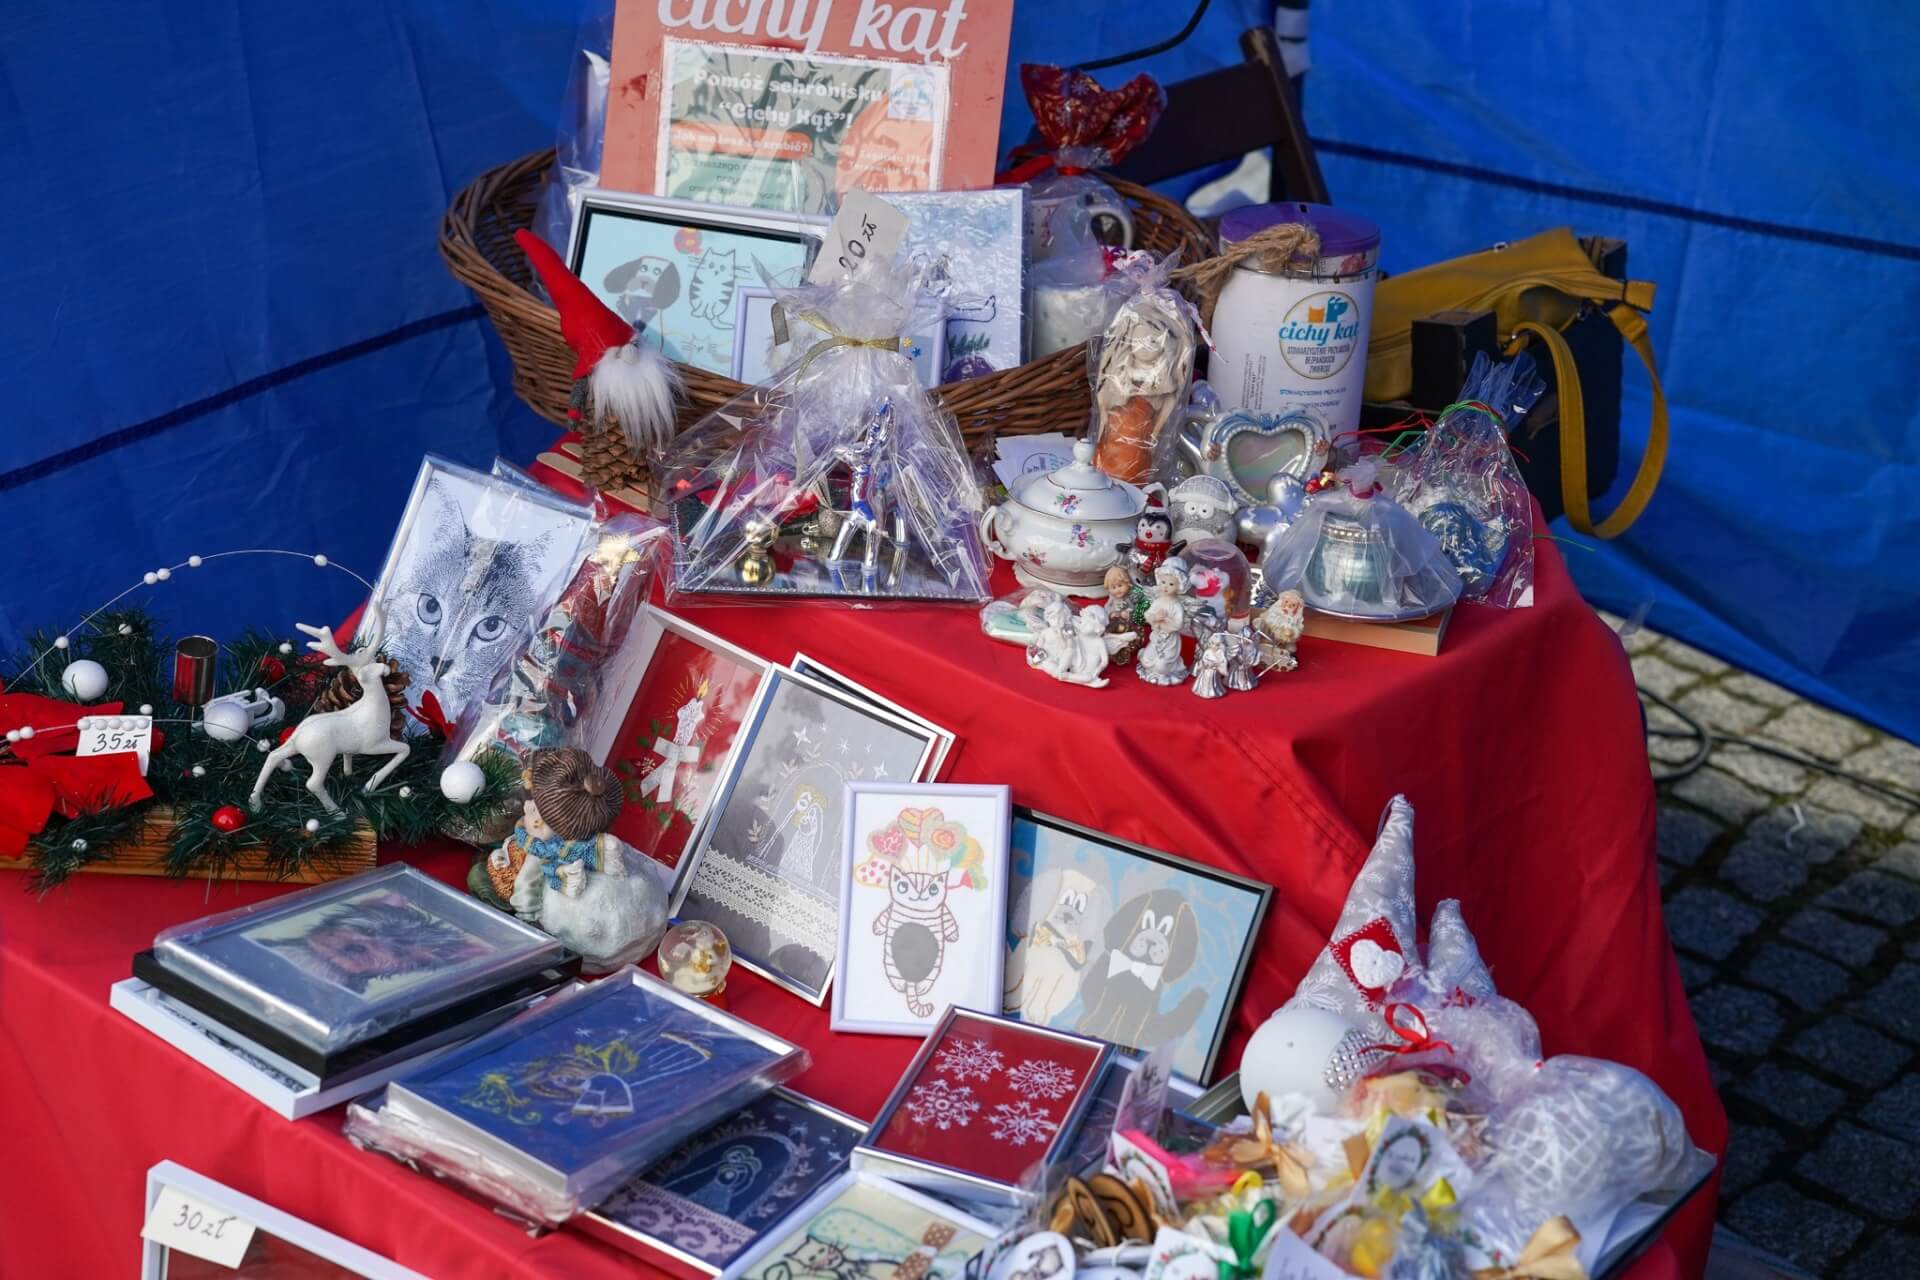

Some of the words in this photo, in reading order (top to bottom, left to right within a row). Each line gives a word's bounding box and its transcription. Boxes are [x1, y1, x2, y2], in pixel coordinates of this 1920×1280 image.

[849, 0, 968, 63] kąt
[694, 70, 763, 91] Pomóż
[1279, 321, 1330, 346] cichy
